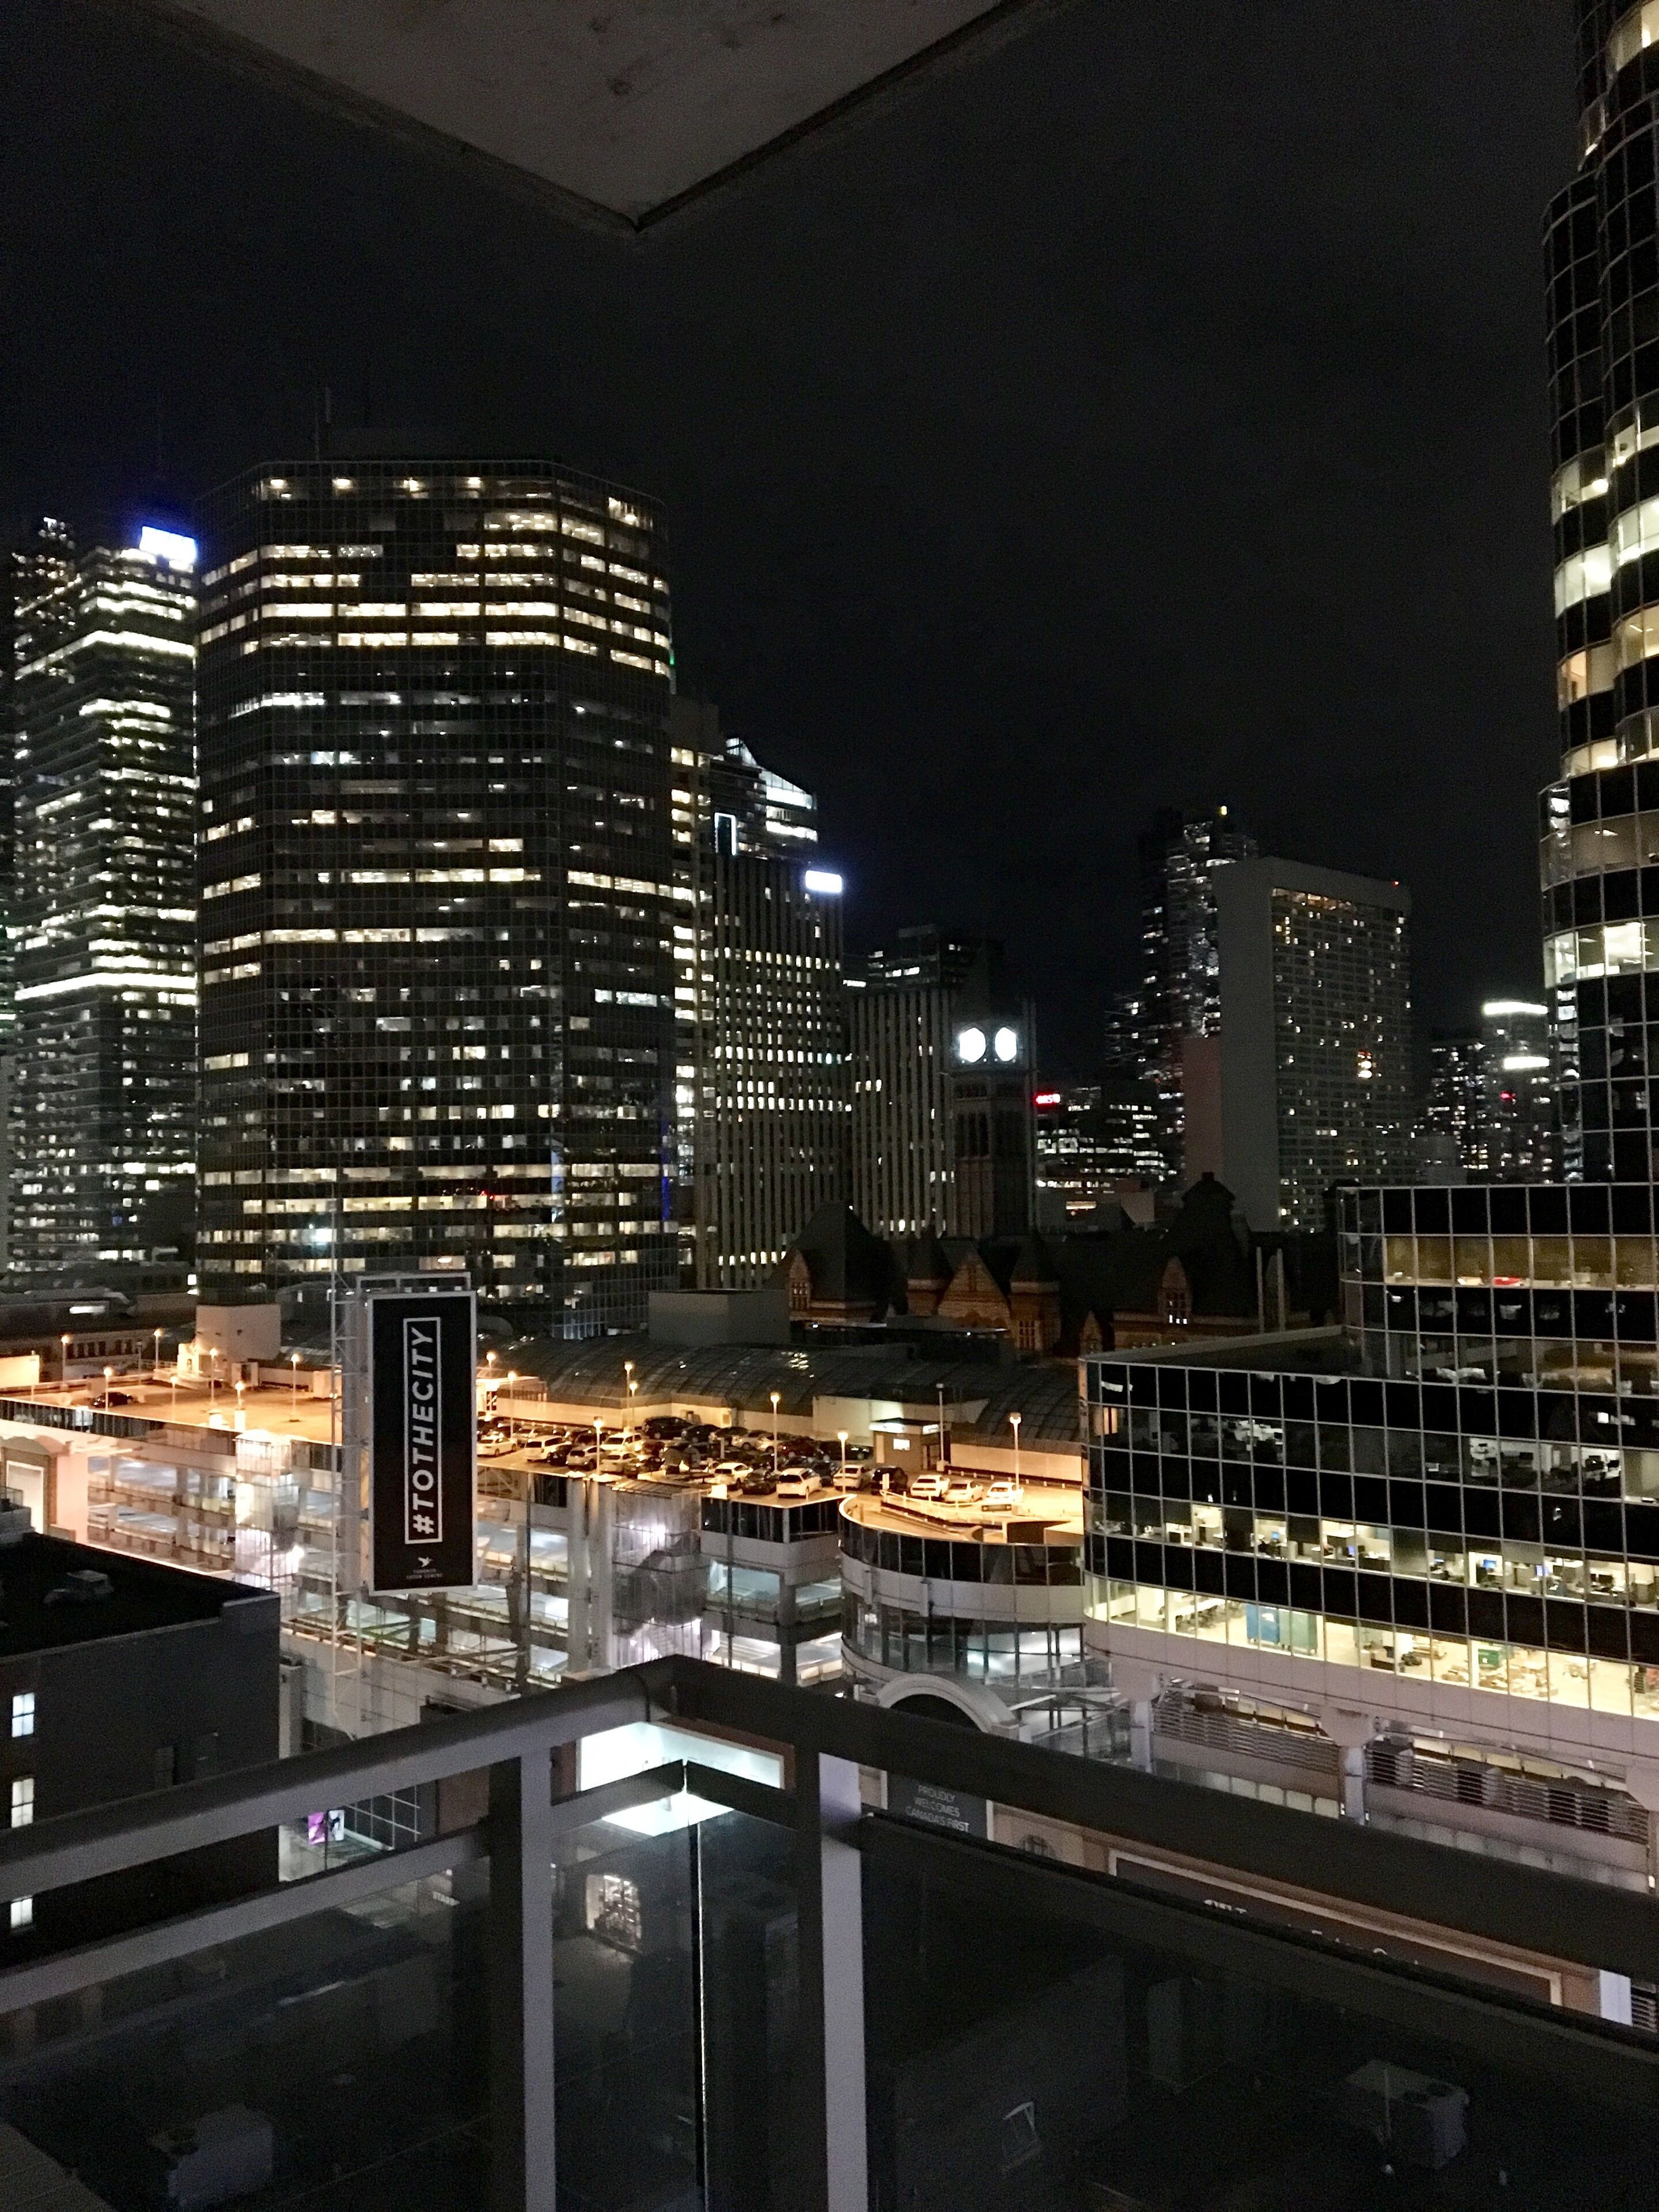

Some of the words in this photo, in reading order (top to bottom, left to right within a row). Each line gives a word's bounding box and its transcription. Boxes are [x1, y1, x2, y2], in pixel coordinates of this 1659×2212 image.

[412, 1327, 434, 1535] #TOTHECITY
[918, 1785, 956, 1802] PROUDLY
[912, 1797, 960, 1817] WELCOMES
[947, 1818, 969, 1832] FIRST
